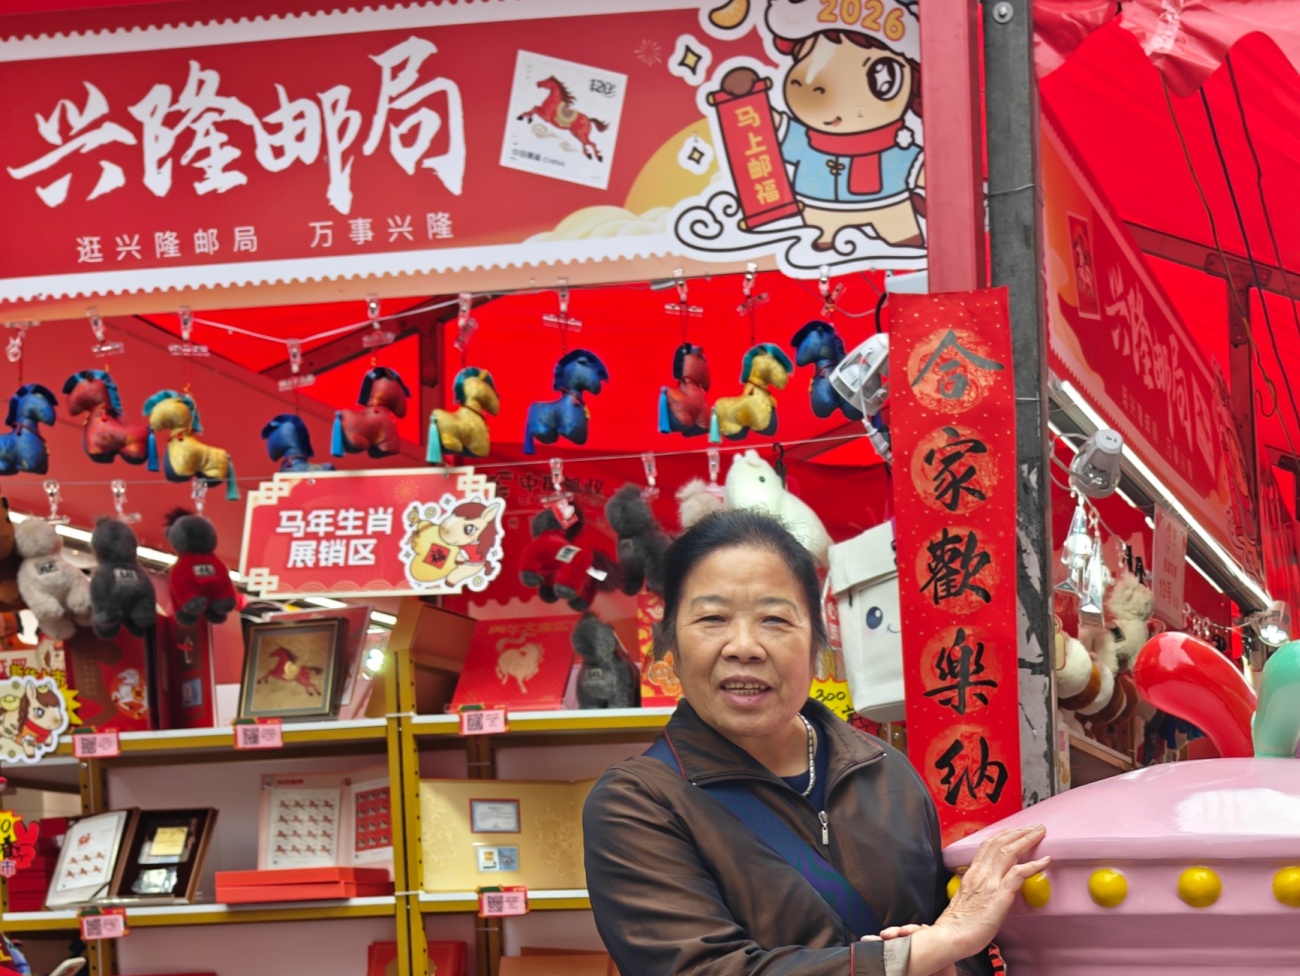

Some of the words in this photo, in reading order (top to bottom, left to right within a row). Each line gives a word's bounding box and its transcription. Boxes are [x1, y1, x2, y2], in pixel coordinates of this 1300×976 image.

[817, 0, 906, 42] 2026
[7, 36, 467, 215] 兴隆邮局
[734, 105, 781, 205] 马上邮福
[76, 226, 259, 263] 逛兴隆邮局
[309, 212, 454, 248] 万事兴隆
[275, 507, 394, 538] 马年生肖
[287, 539, 378, 568] 展销区
